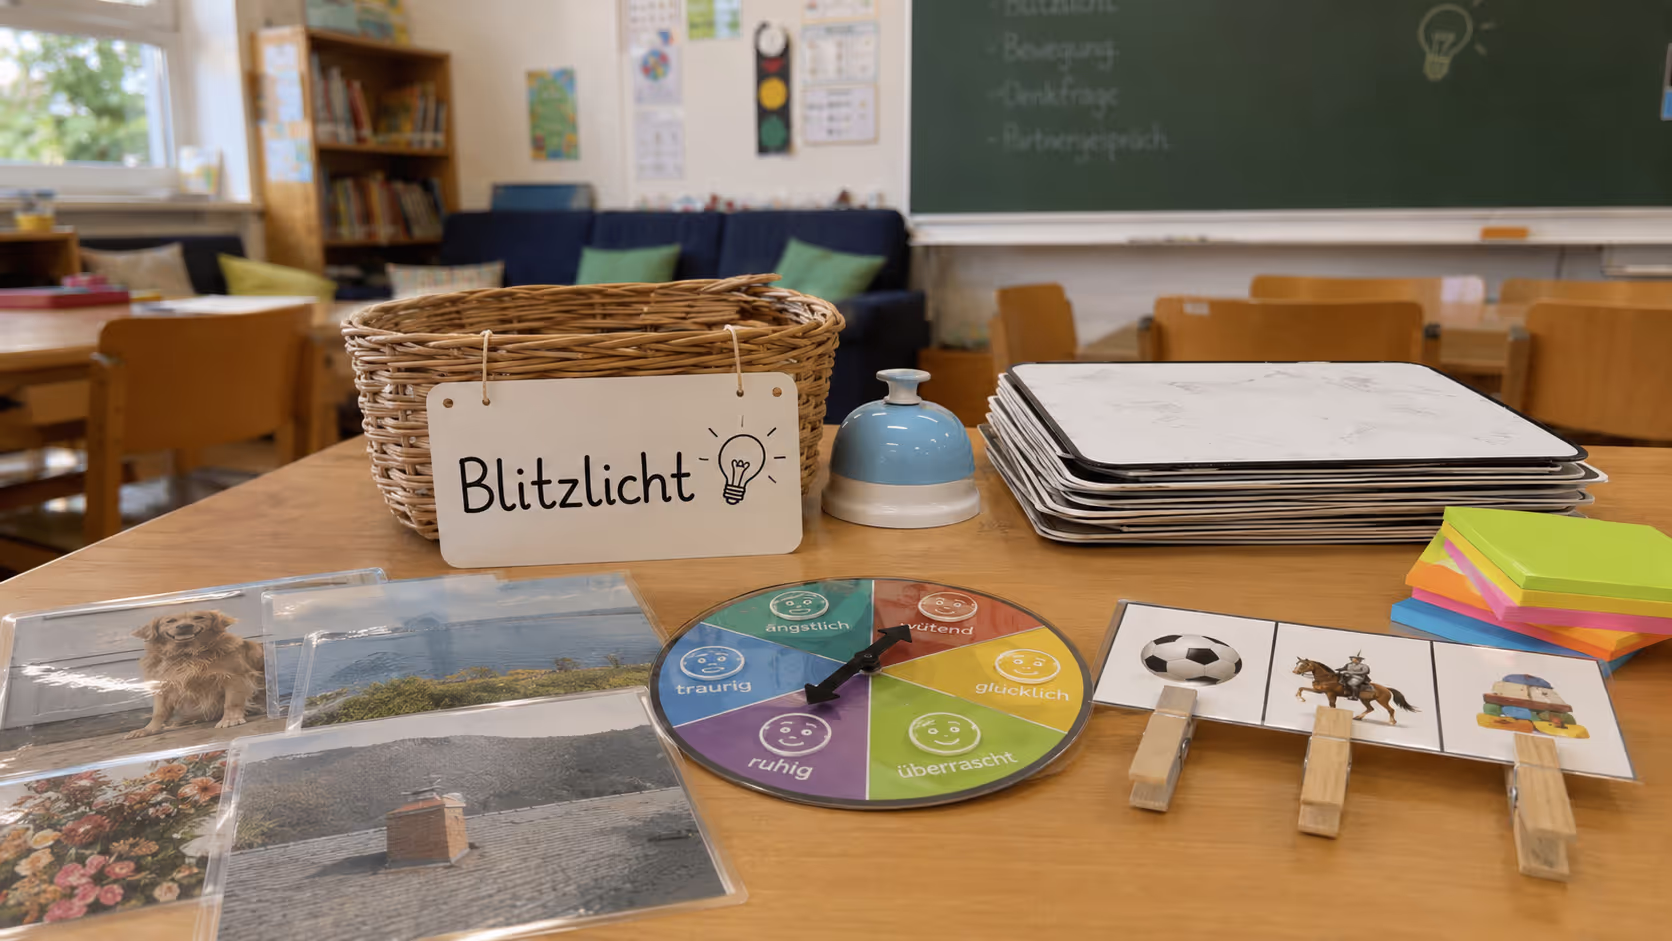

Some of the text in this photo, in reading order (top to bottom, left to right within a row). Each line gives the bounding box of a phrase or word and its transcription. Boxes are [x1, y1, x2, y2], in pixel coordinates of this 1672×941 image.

[459, 451, 695, 514] Blitzlicht
[675, 680, 752, 695] traurig
[747, 757, 814, 781] ruhig
[897, 751, 1019, 779] überrascht
